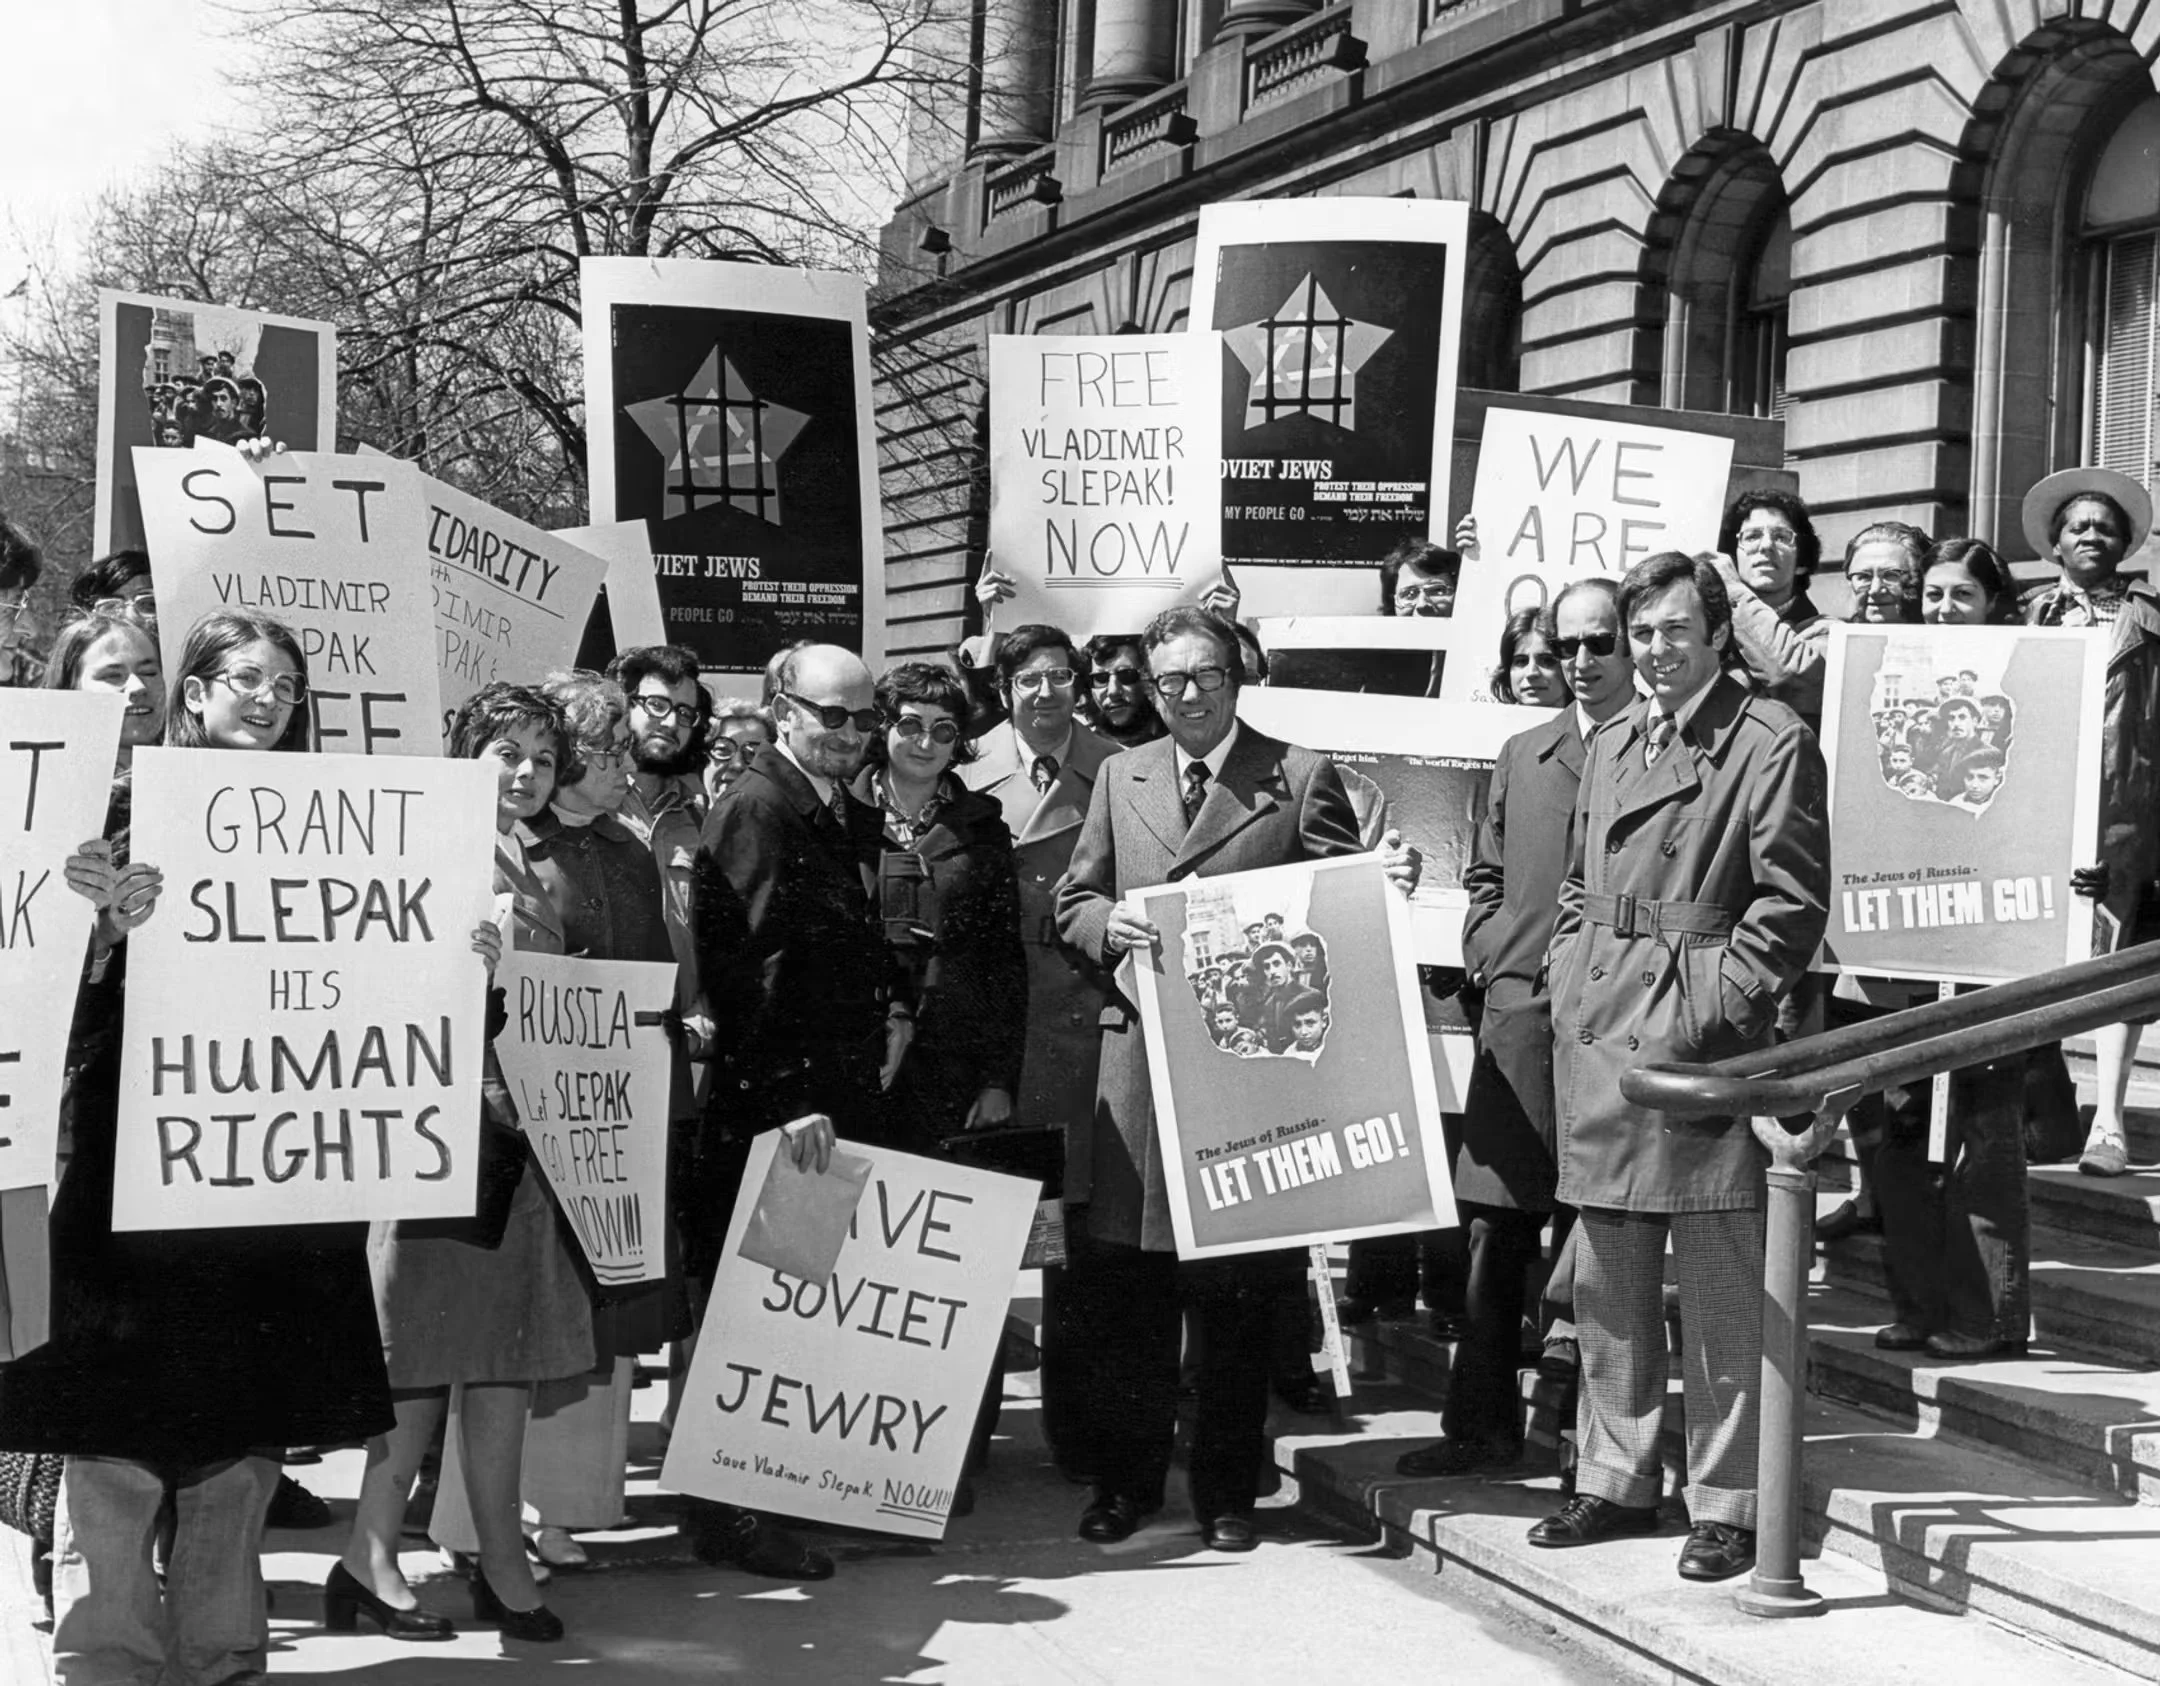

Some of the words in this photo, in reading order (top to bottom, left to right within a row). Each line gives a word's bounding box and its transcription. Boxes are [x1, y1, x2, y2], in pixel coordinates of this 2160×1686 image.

[1041, 351, 1178, 407] FREE
[1022, 425, 1184, 461] VLADIMIR
[1042, 465, 1174, 506] SLEPAK!
[1278, 459, 1333, 481] JEWS
[1313, 481, 1350, 491] PROTEST
[1351, 481, 1376, 492] THEIR
[1377, 482, 1426, 493] OPPRESSION
[1528, 434, 1665, 508] WE
[182, 469, 386, 543] SET
[1224, 506, 1241, 520] MY
[1245, 506, 1286, 521] PEOPLE
[1289, 506, 1306, 521] GO
[1313, 491, 1348, 501] DEMAND
[1349, 492, 1374, 502] THEIR
[1375, 492, 1414, 502] FREEDOM
[704, 555, 761, 579] JEWS
[1047, 518, 1189, 576] NOW
[212, 573, 391, 613] VLADIMIR
[742, 580, 780, 592] PROTEST
[780, 582, 807, 593] THEIR
[808, 583, 859, 594] OPPRESSION
[742, 591, 779, 602] DEMAND
[780, 593, 806, 604] THEIR
[806, 593, 847, 605] FREEDOM
[670, 607, 713, 623] PEOPLE
[717, 608, 734, 623] GO
[1425, 758, 1449, 768] world
[206, 787, 424, 855] GRANT
[1842, 873, 1869, 886] The
[1871, 871, 1905, 883] Jews
[1908, 868, 1922, 882] of
[184, 878, 434, 943] SLEPAK
[1841, 888, 1892, 933] LET
[1897, 880, 1985, 929] THEM
[1992, 874, 2056, 923] GO!
[270, 969, 341, 1010] HIS
[152, 1015, 454, 1096] HUMAN
[555, 1069, 633, 1122] SLEPAK
[157, 1105, 452, 1187] RIGHTS
[569, 1123, 629, 1186] FREE
[1195, 1147, 1222, 1162] The
[1224, 1136, 1257, 1155] Jews
[1258, 1129, 1274, 1144] of
[1199, 1156, 1253, 1212] LET
[1251, 1130, 1344, 1196] THEM
[1343, 1111, 1411, 1171] GO!
[849, 1180, 974, 1263] VE
[762, 1270, 968, 1351] SOVIET
[715, 1361, 948, 1455] JEWRY
[712, 1448, 748, 1472] Save
[754, 1453, 811, 1486] Vladimir
